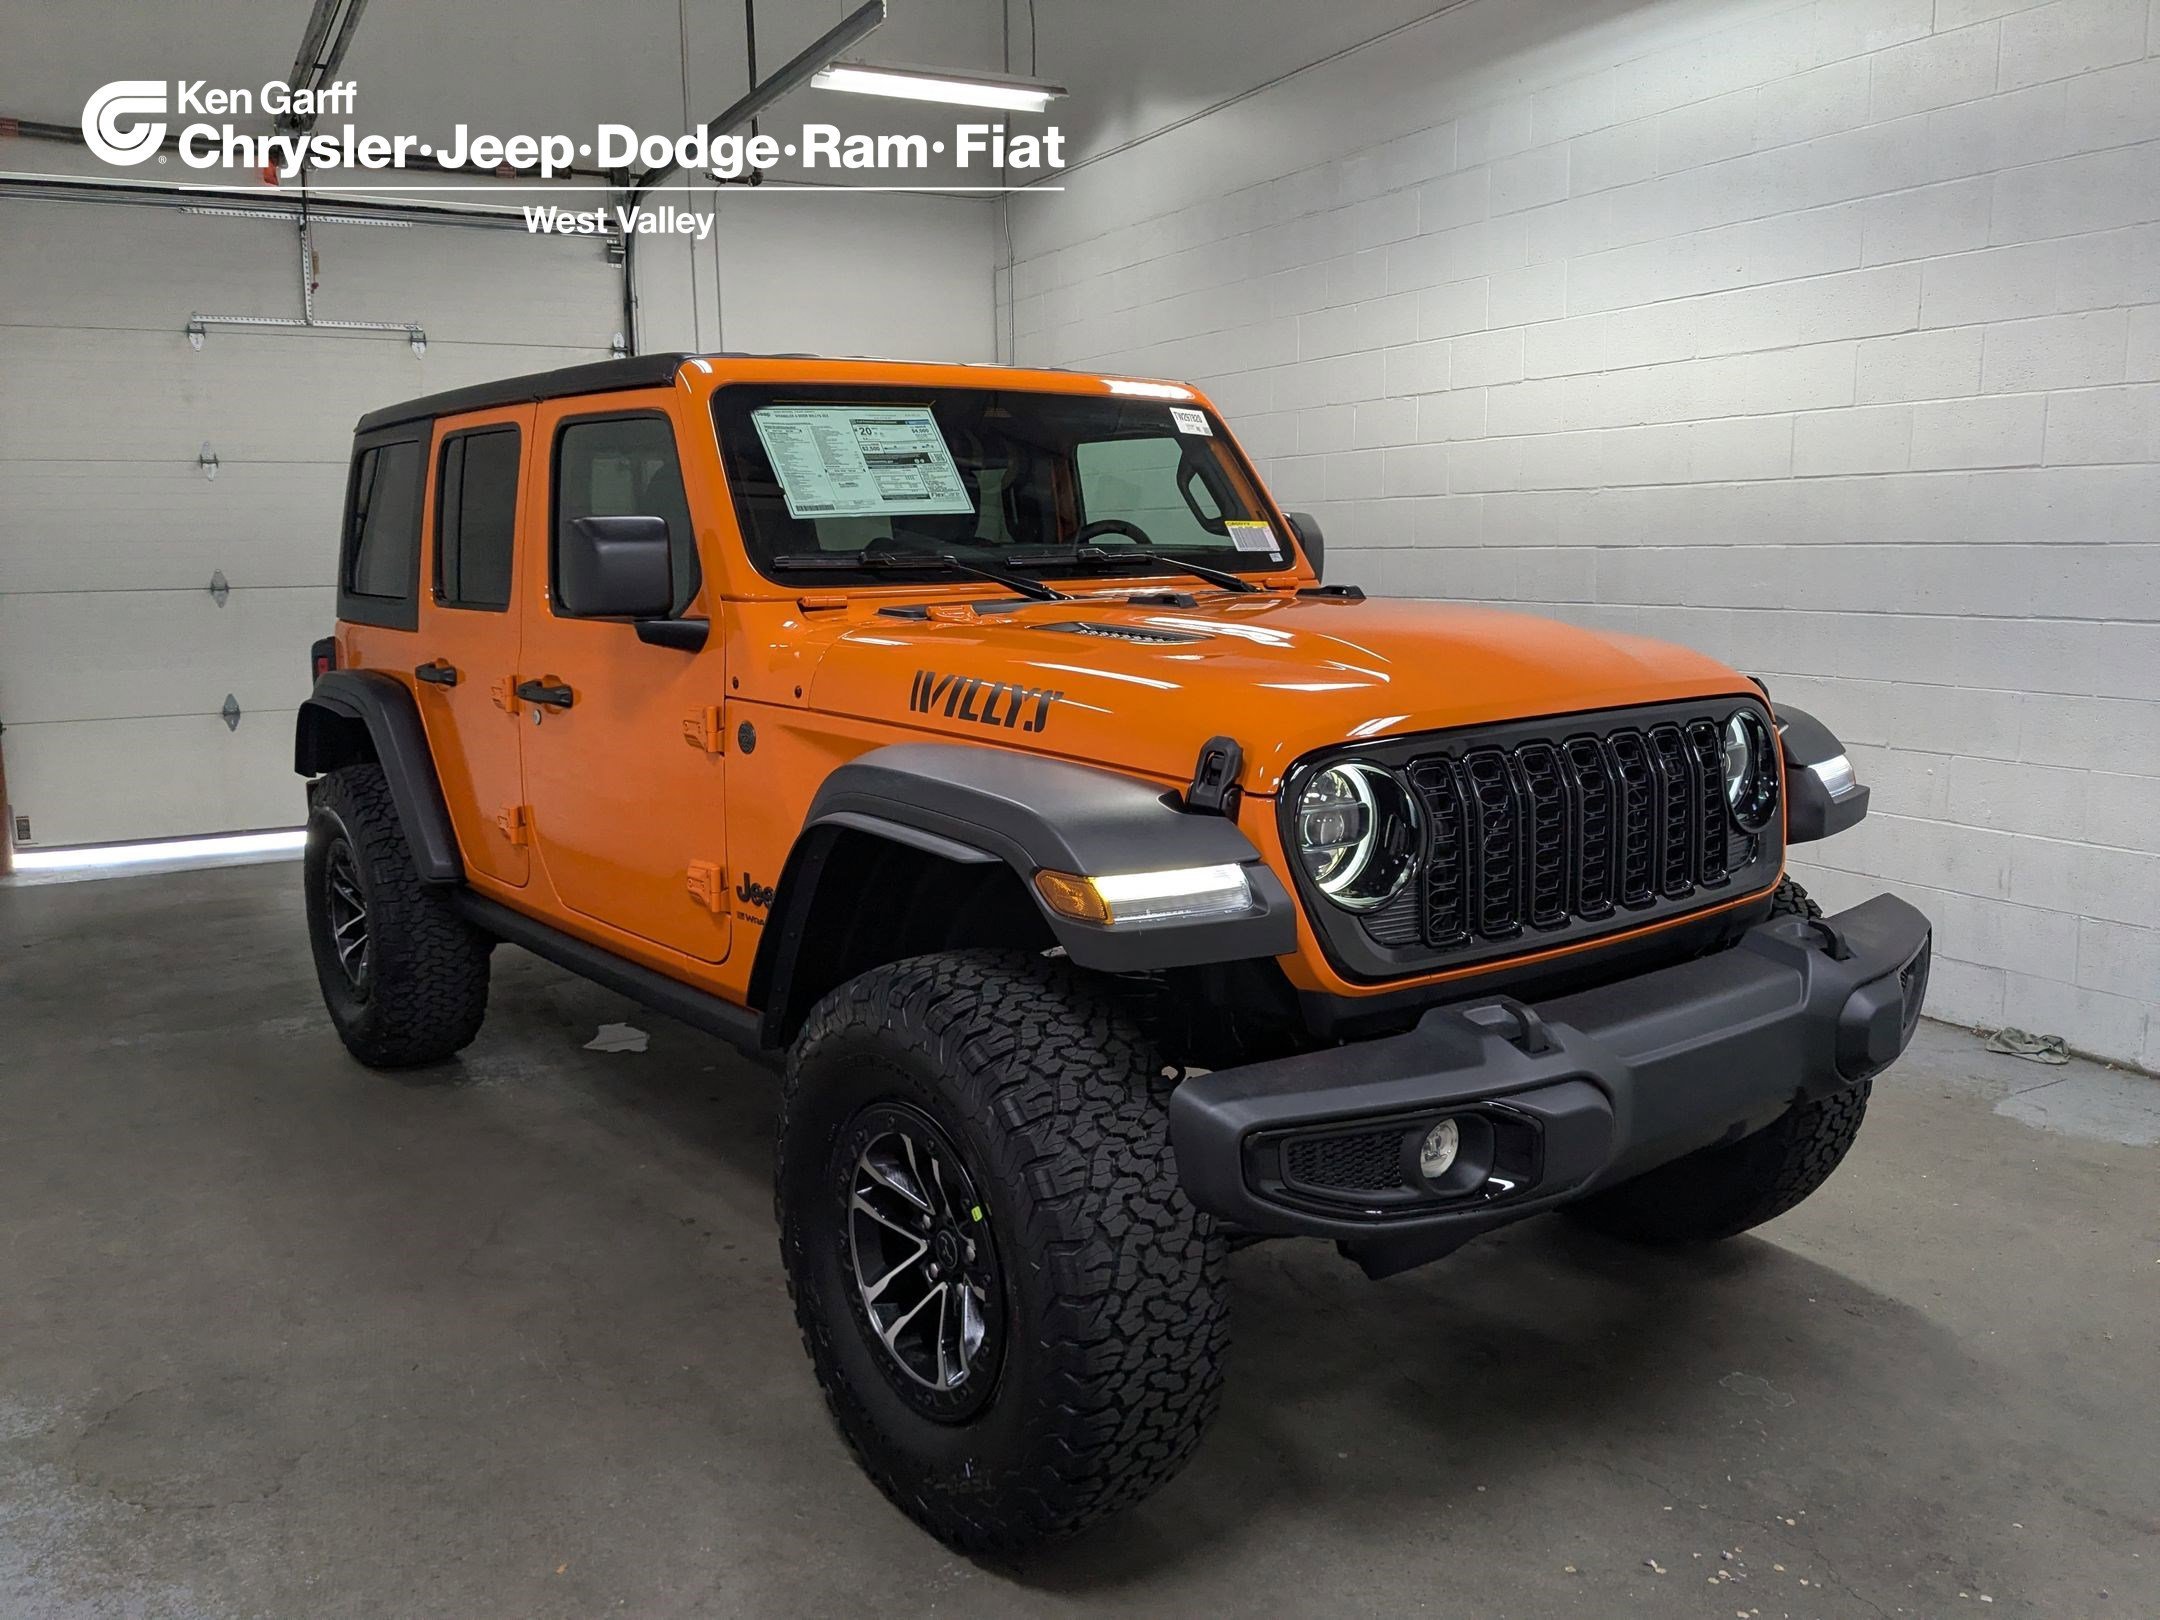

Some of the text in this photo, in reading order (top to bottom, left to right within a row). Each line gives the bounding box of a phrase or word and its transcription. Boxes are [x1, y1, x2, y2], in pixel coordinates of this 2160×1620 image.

[859, 427, 872, 436] 20
[909, 669, 1065, 733] WILLYS
[736, 872, 774, 909] Jee
